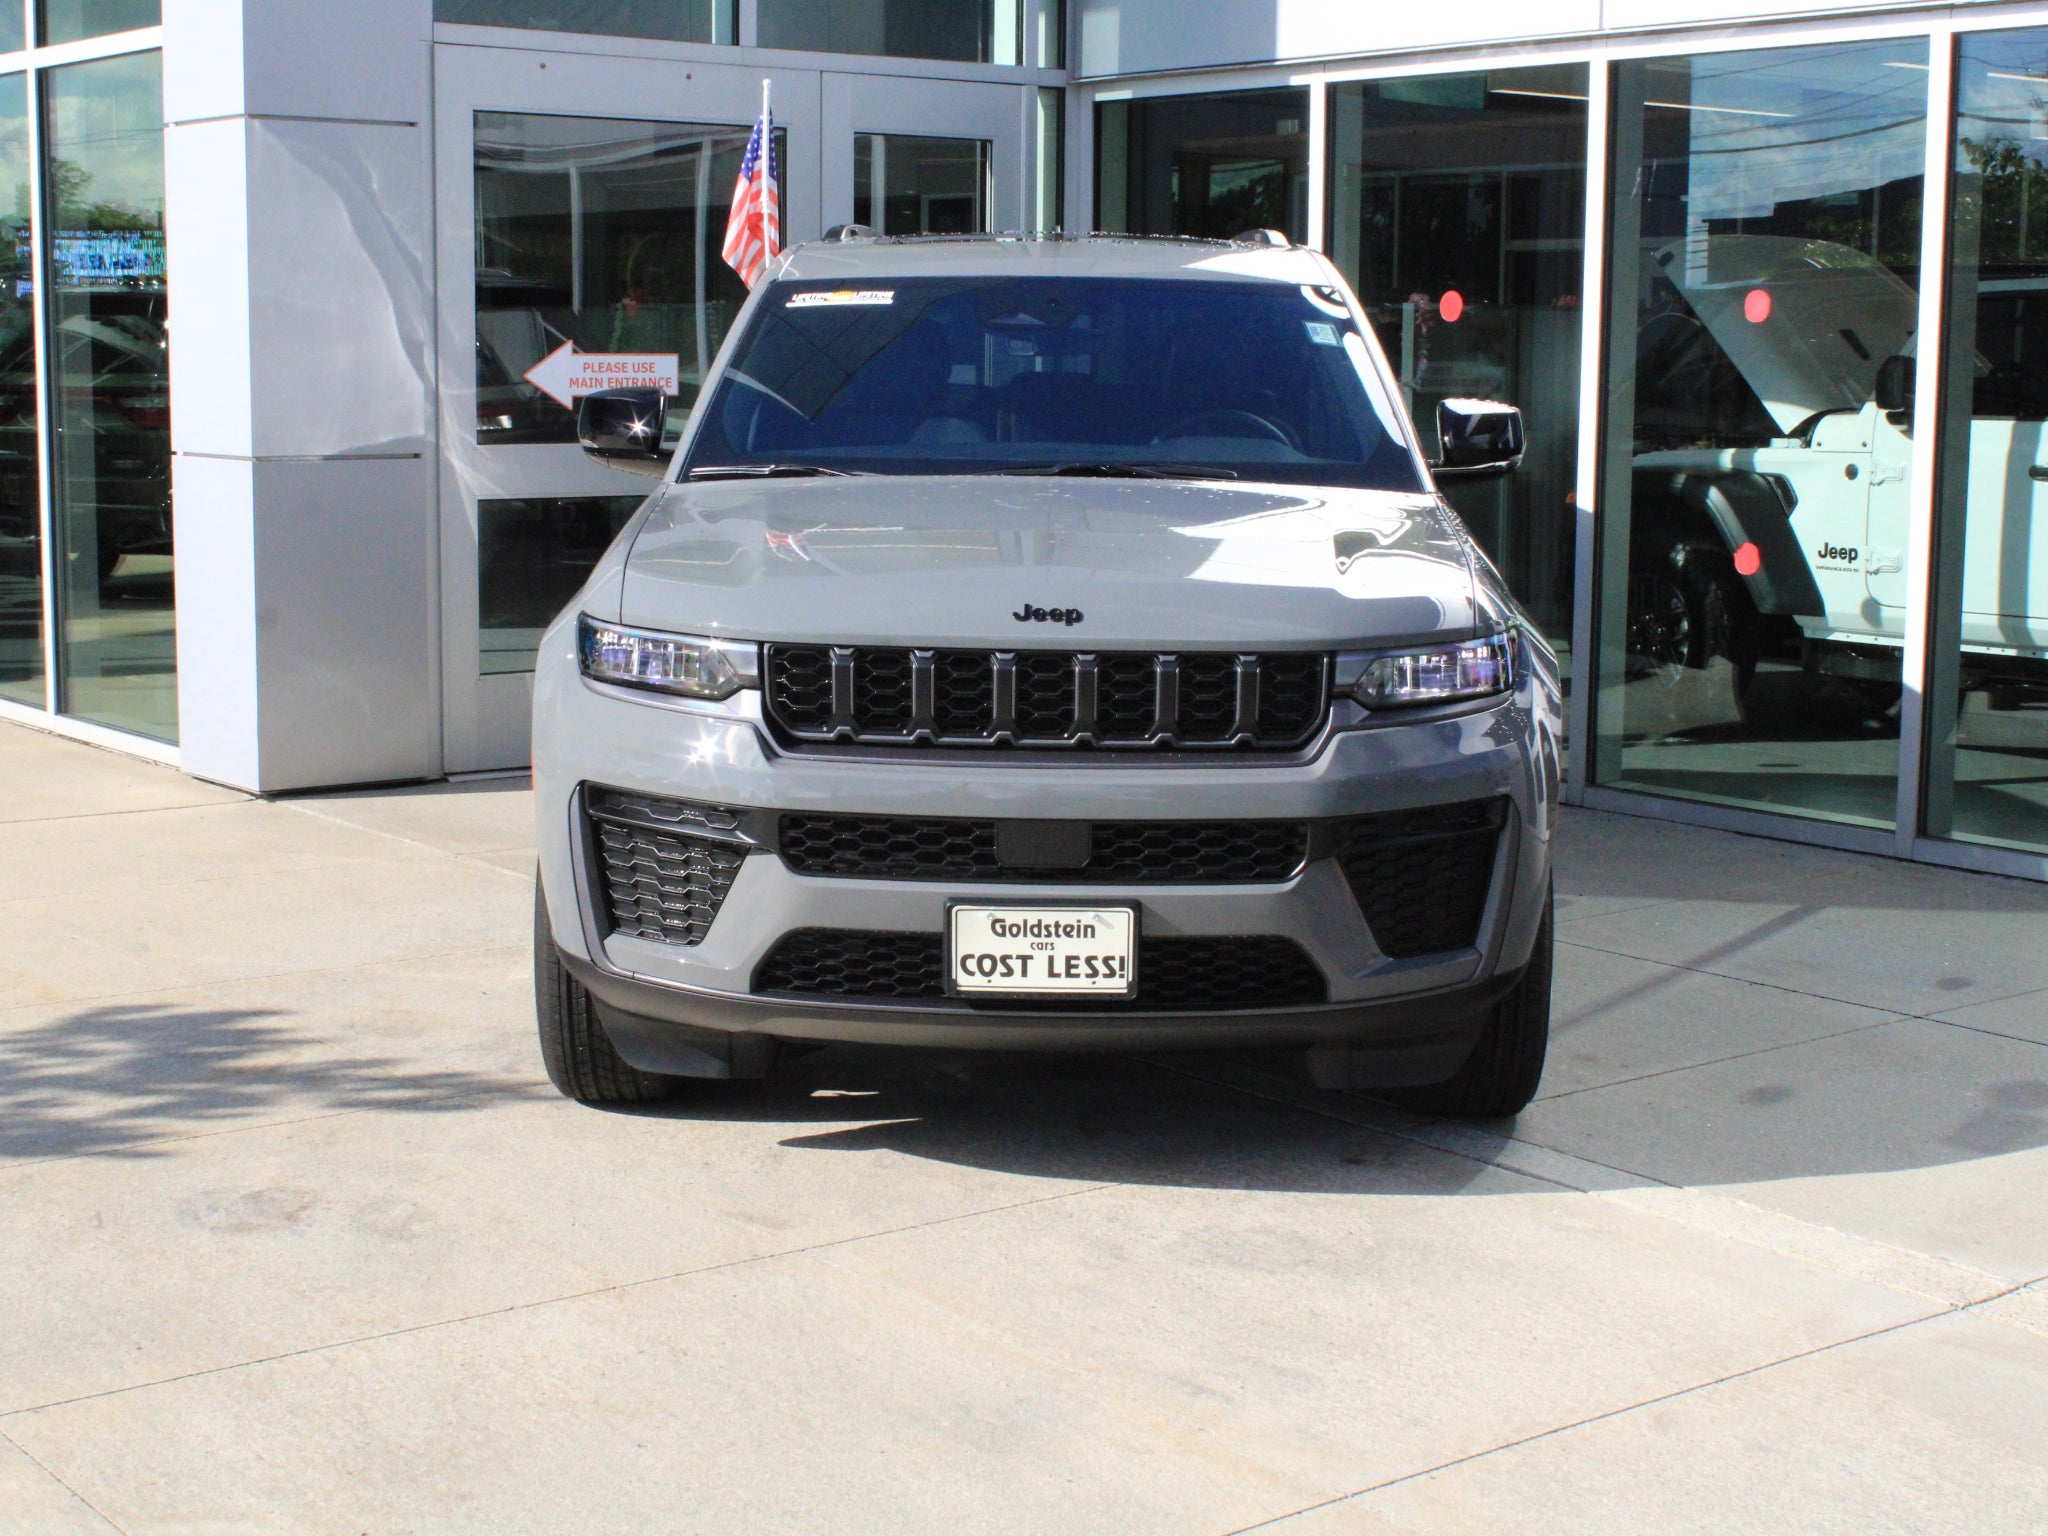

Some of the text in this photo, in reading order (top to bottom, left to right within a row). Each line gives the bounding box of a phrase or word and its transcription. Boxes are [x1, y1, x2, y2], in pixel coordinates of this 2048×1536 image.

[583, 362, 656, 374] PLEASE USE
[569, 377, 672, 389] MAIN ENTRANCE
[1817, 541, 1858, 564] Jeep
[1815, 564, 1852, 573] WRANGLER
[1012, 603, 1084, 627] Jeep
[990, 918, 1096, 939] Goldstein
[1030, 941, 1055, 951] cars
[960, 953, 1126, 979] COST LESS!
